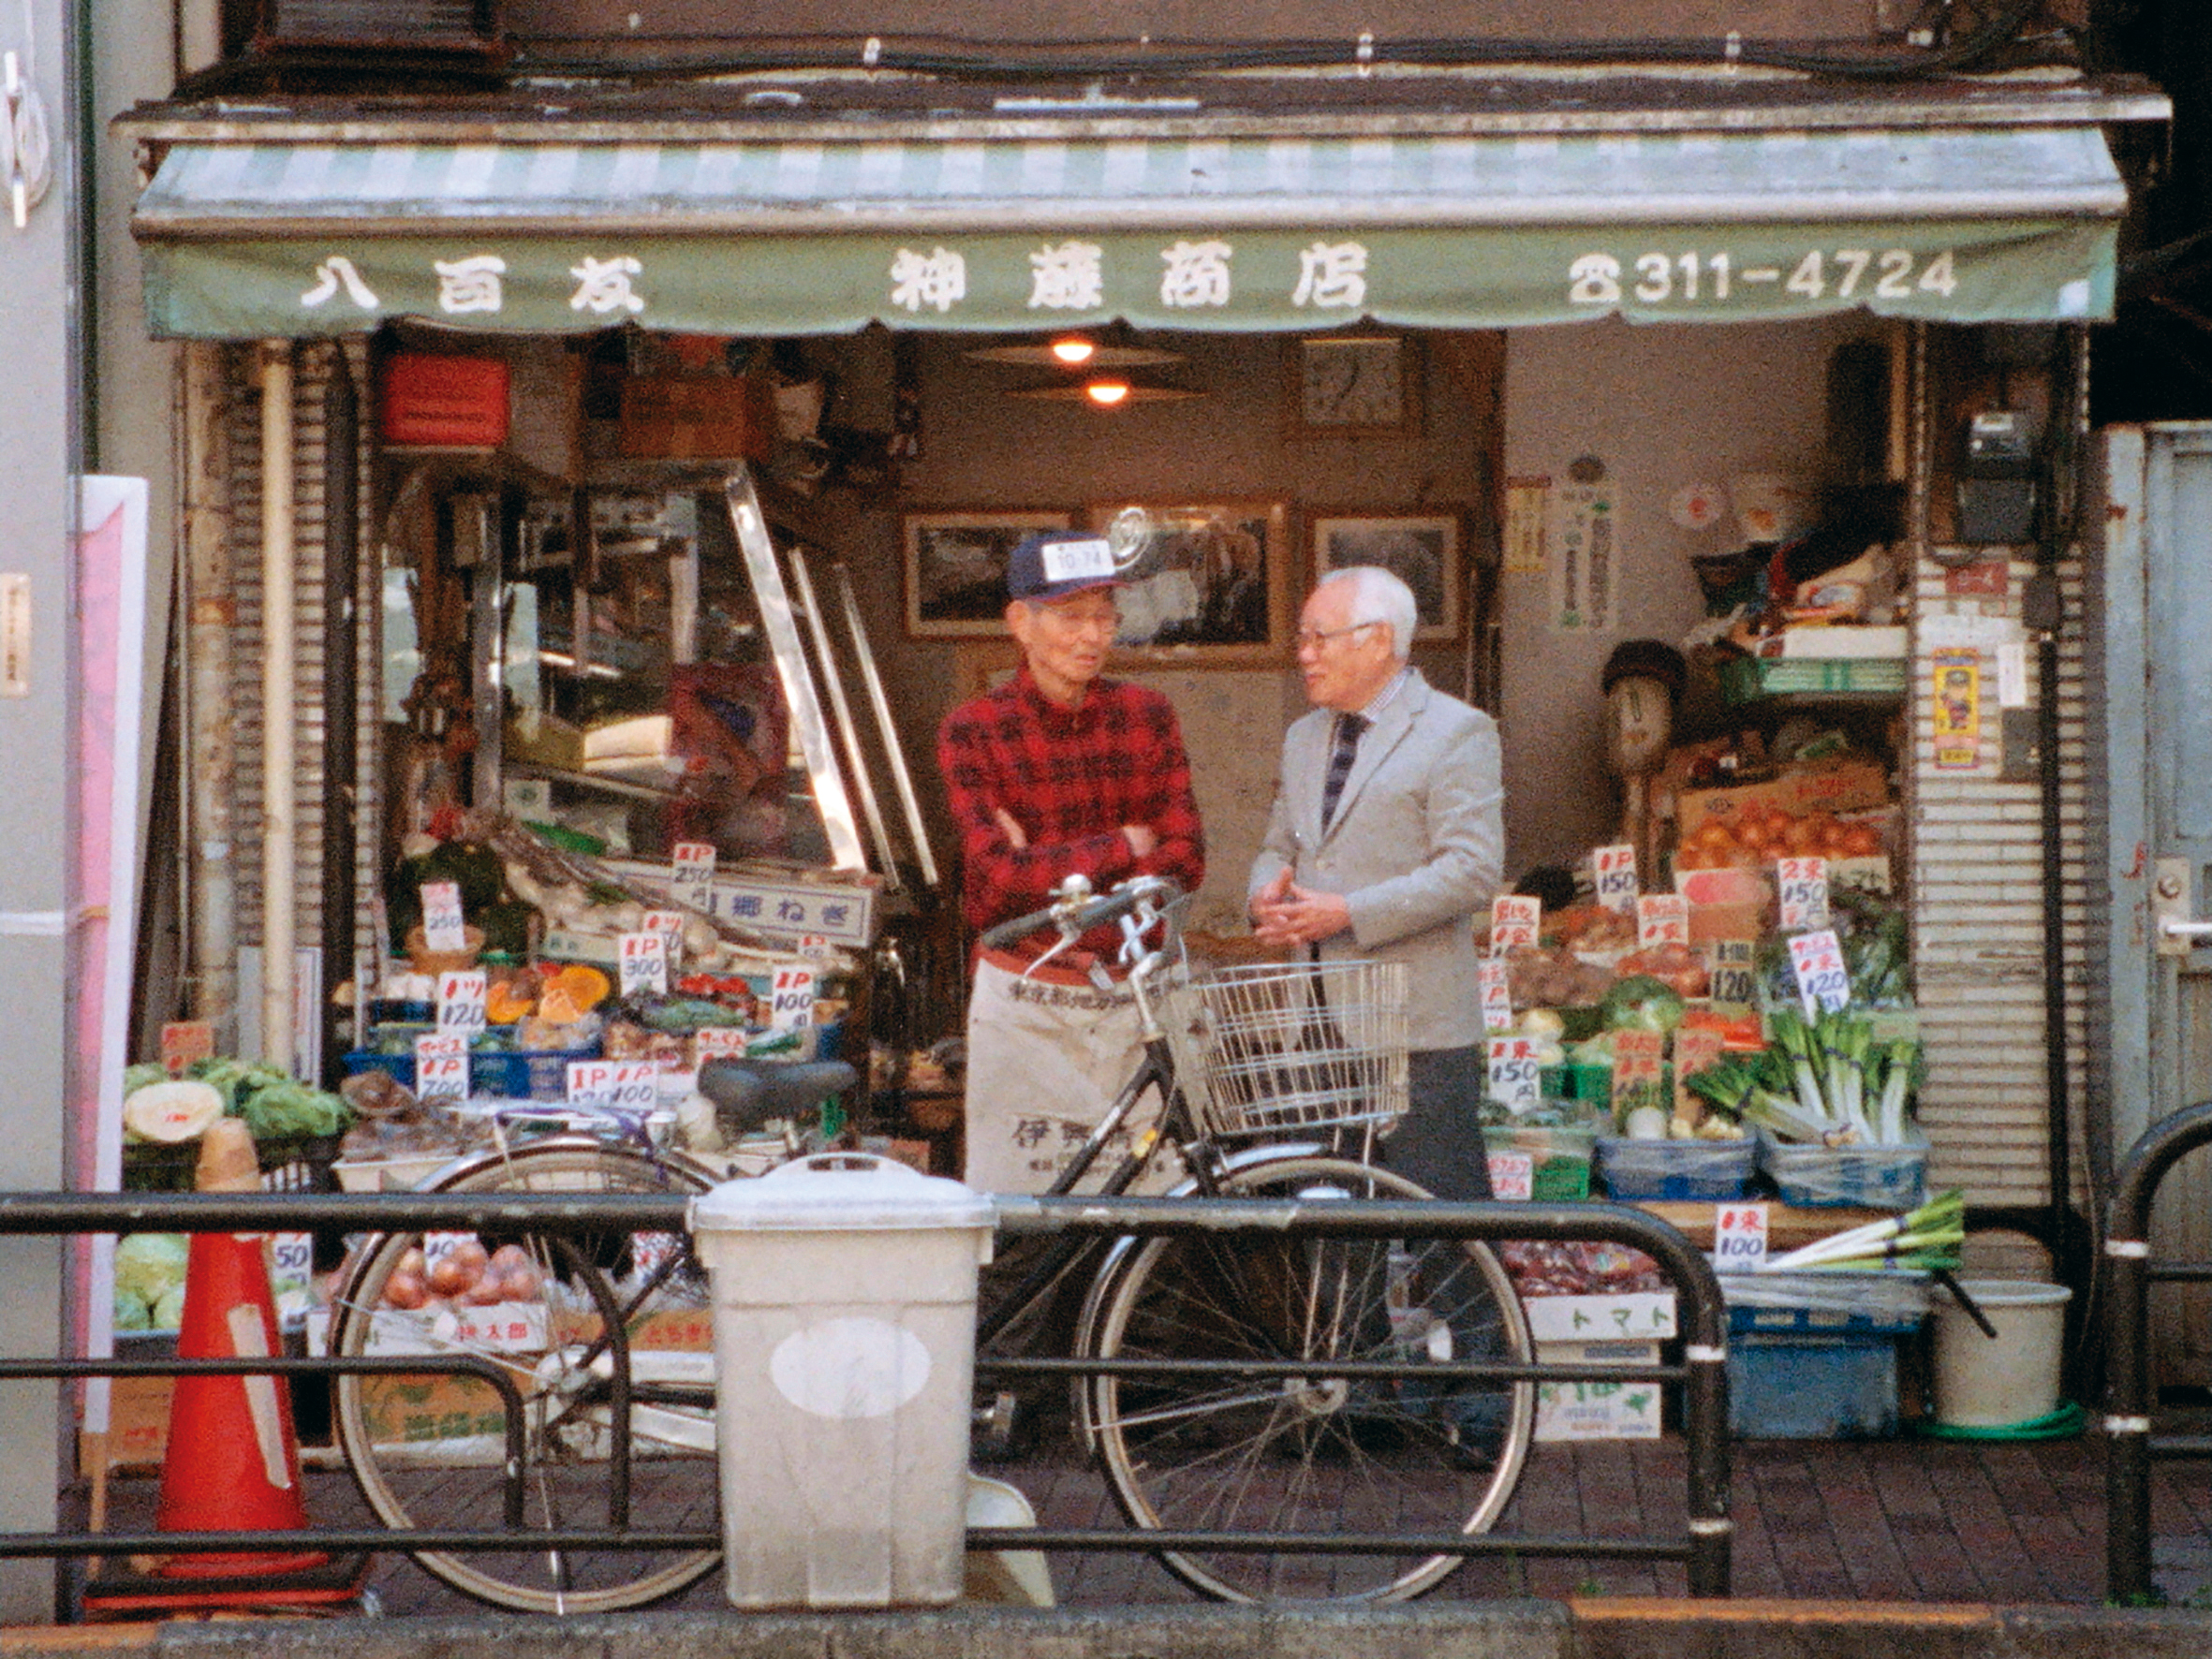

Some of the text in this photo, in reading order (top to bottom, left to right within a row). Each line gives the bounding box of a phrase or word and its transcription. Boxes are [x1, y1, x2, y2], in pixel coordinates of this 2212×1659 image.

[1634, 249, 1957, 301] 311-4724
[775, 972, 811, 990] 1P
[774, 993, 813, 1012] 100
[443, 1004, 486, 1026] 120
[423, 1059, 461, 1076] 1P
[1492, 1060, 1539, 1083] 150
[573, 1068, 608, 1090] 1P
[1720, 1237, 1763, 1256] 100
[1572, 1305, 1670, 1330] トマト
